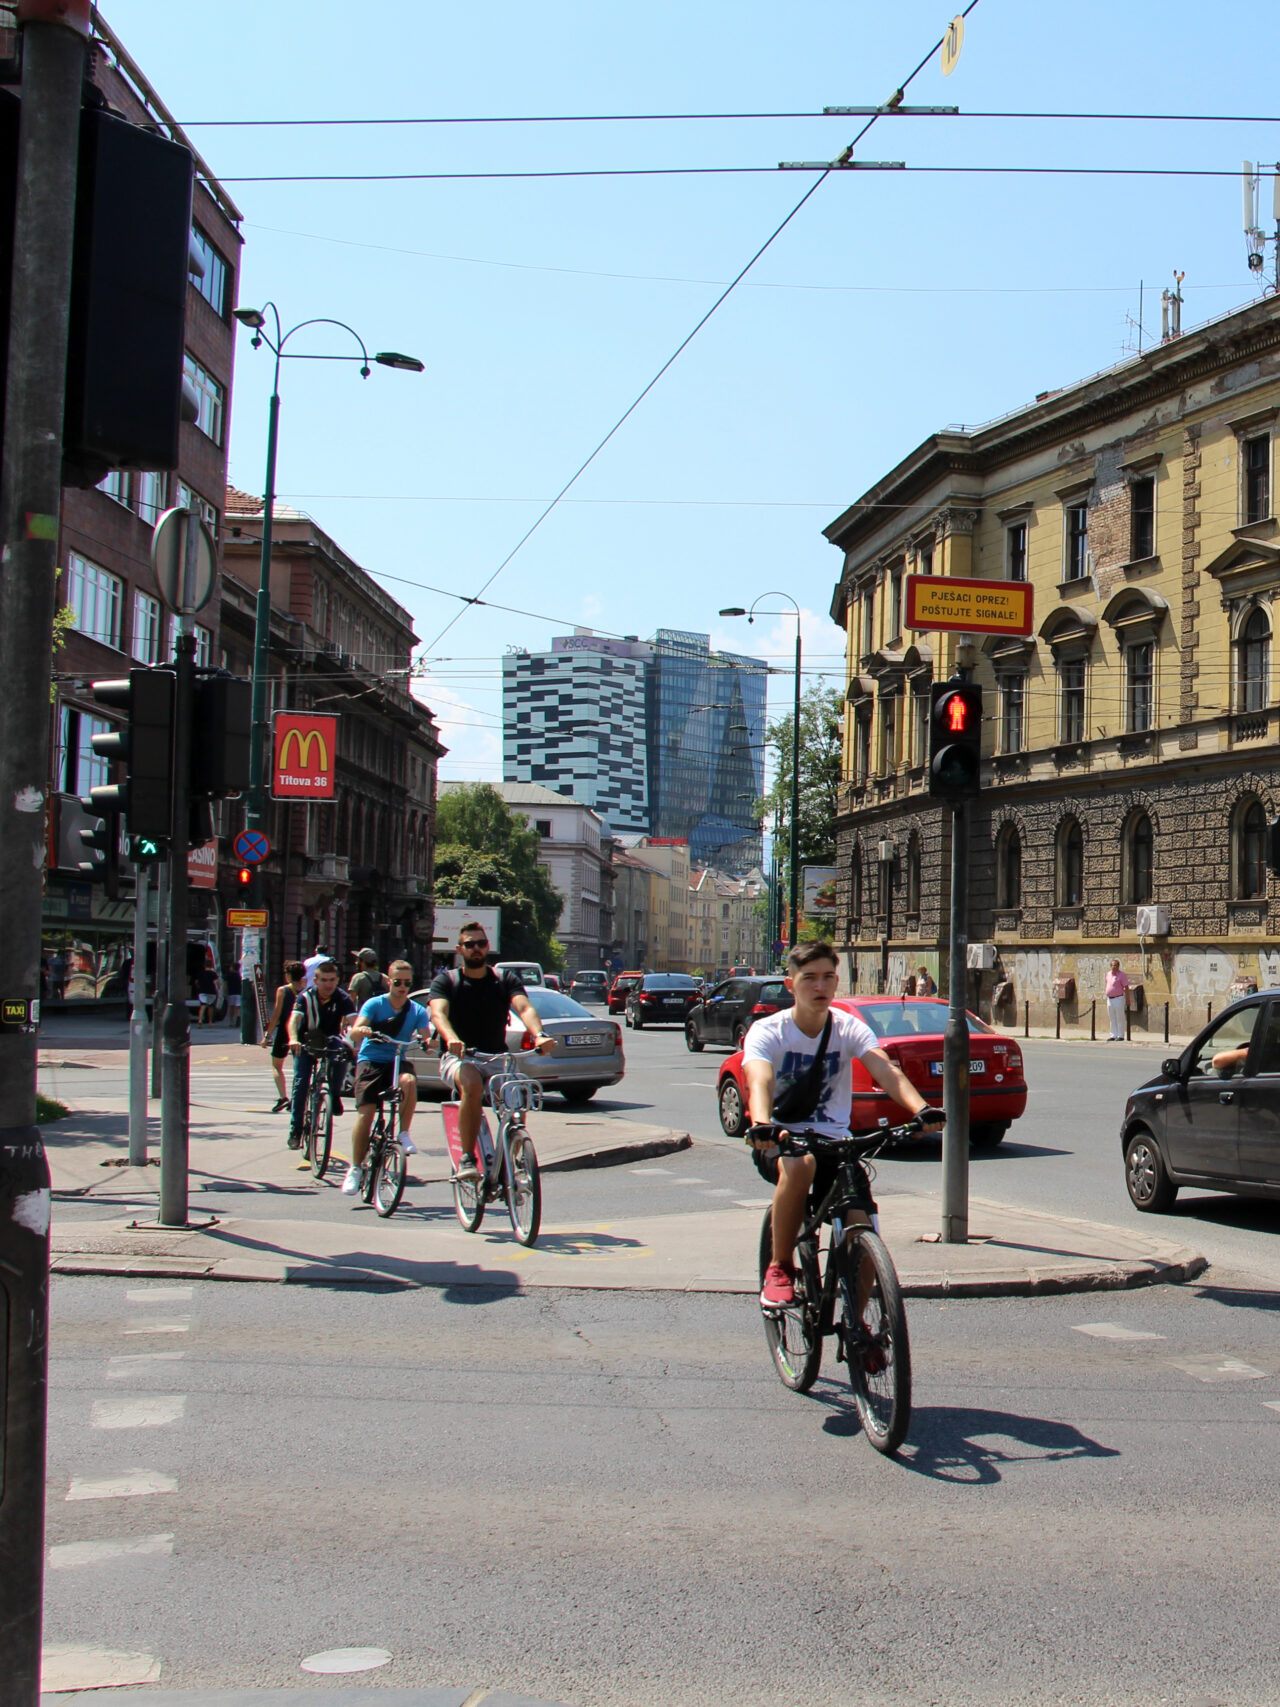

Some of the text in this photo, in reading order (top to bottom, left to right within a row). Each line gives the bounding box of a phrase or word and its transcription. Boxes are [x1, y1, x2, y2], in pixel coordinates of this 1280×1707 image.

[930, 591, 1009, 606] PJEŠACI OPREZ!
[921, 605, 1018, 620] POŠTUJTE SIGNALE!
[279, 775, 328, 787] Titova 36
